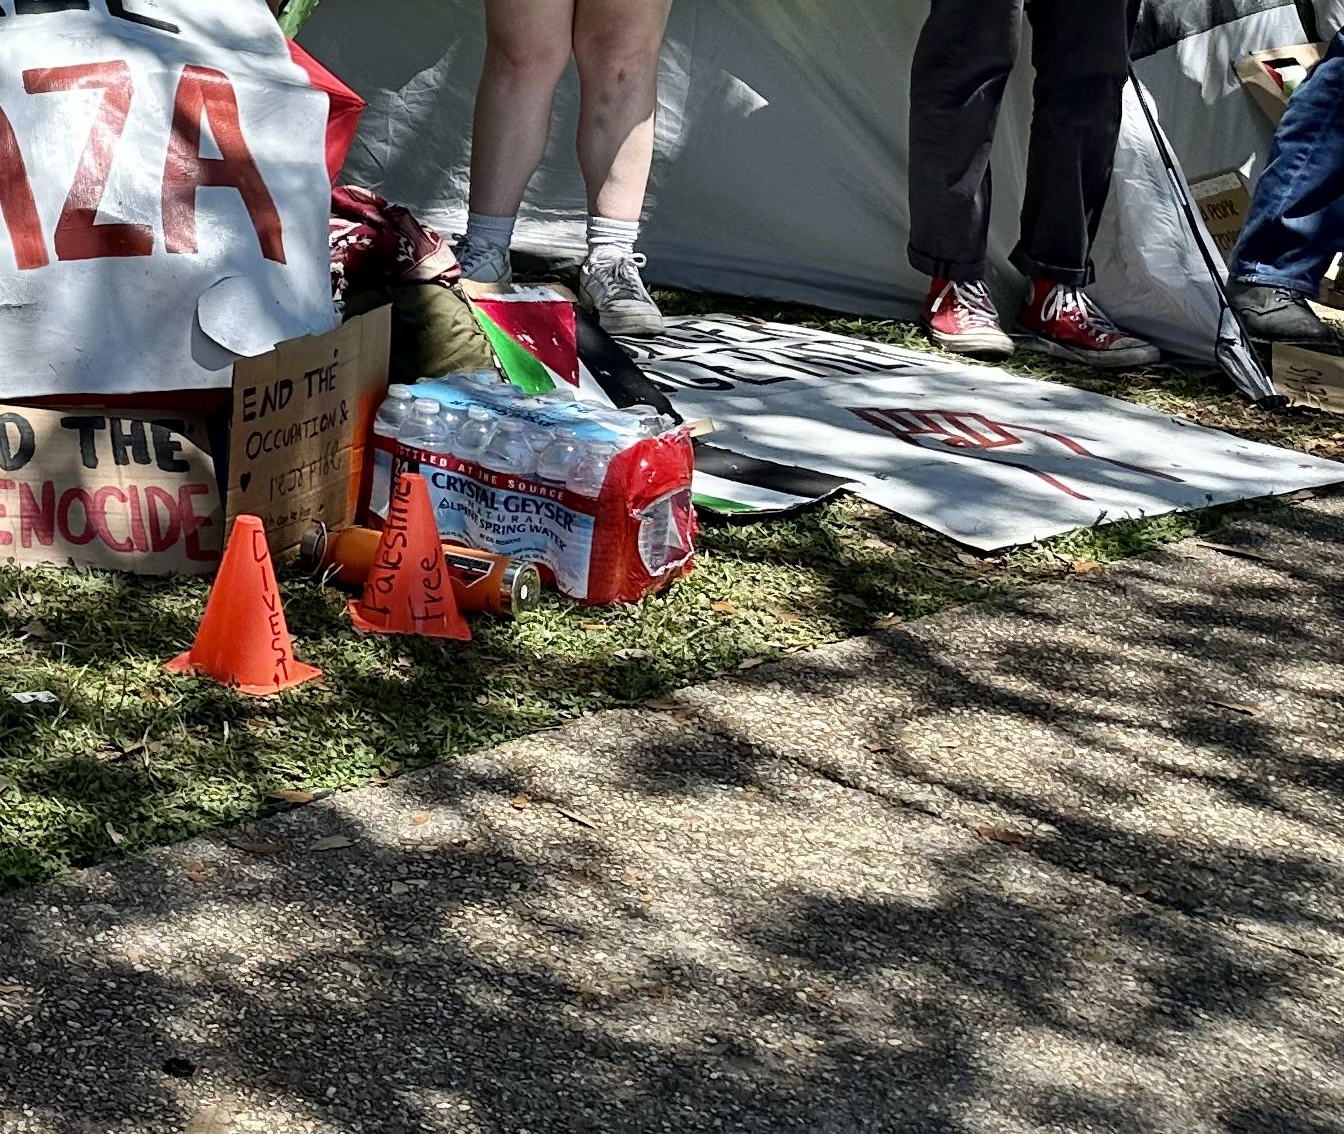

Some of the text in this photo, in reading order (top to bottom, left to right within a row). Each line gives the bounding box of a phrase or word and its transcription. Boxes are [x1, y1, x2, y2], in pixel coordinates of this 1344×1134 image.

[243, 361, 339, 422] END THE
[60, 414, 192, 473] THE
[246, 410, 337, 460] OCCUPATION
[431, 471, 499, 510] CRYSTAL
[504, 495, 574, 533] GEYSER
[508, 478, 564, 501] SOURCE
[359, 479, 412, 615] Palestine
[480, 519, 527, 535] SPRING
[530, 524, 568, 552] WATER
[253, 529, 289, 681] DIVEST
